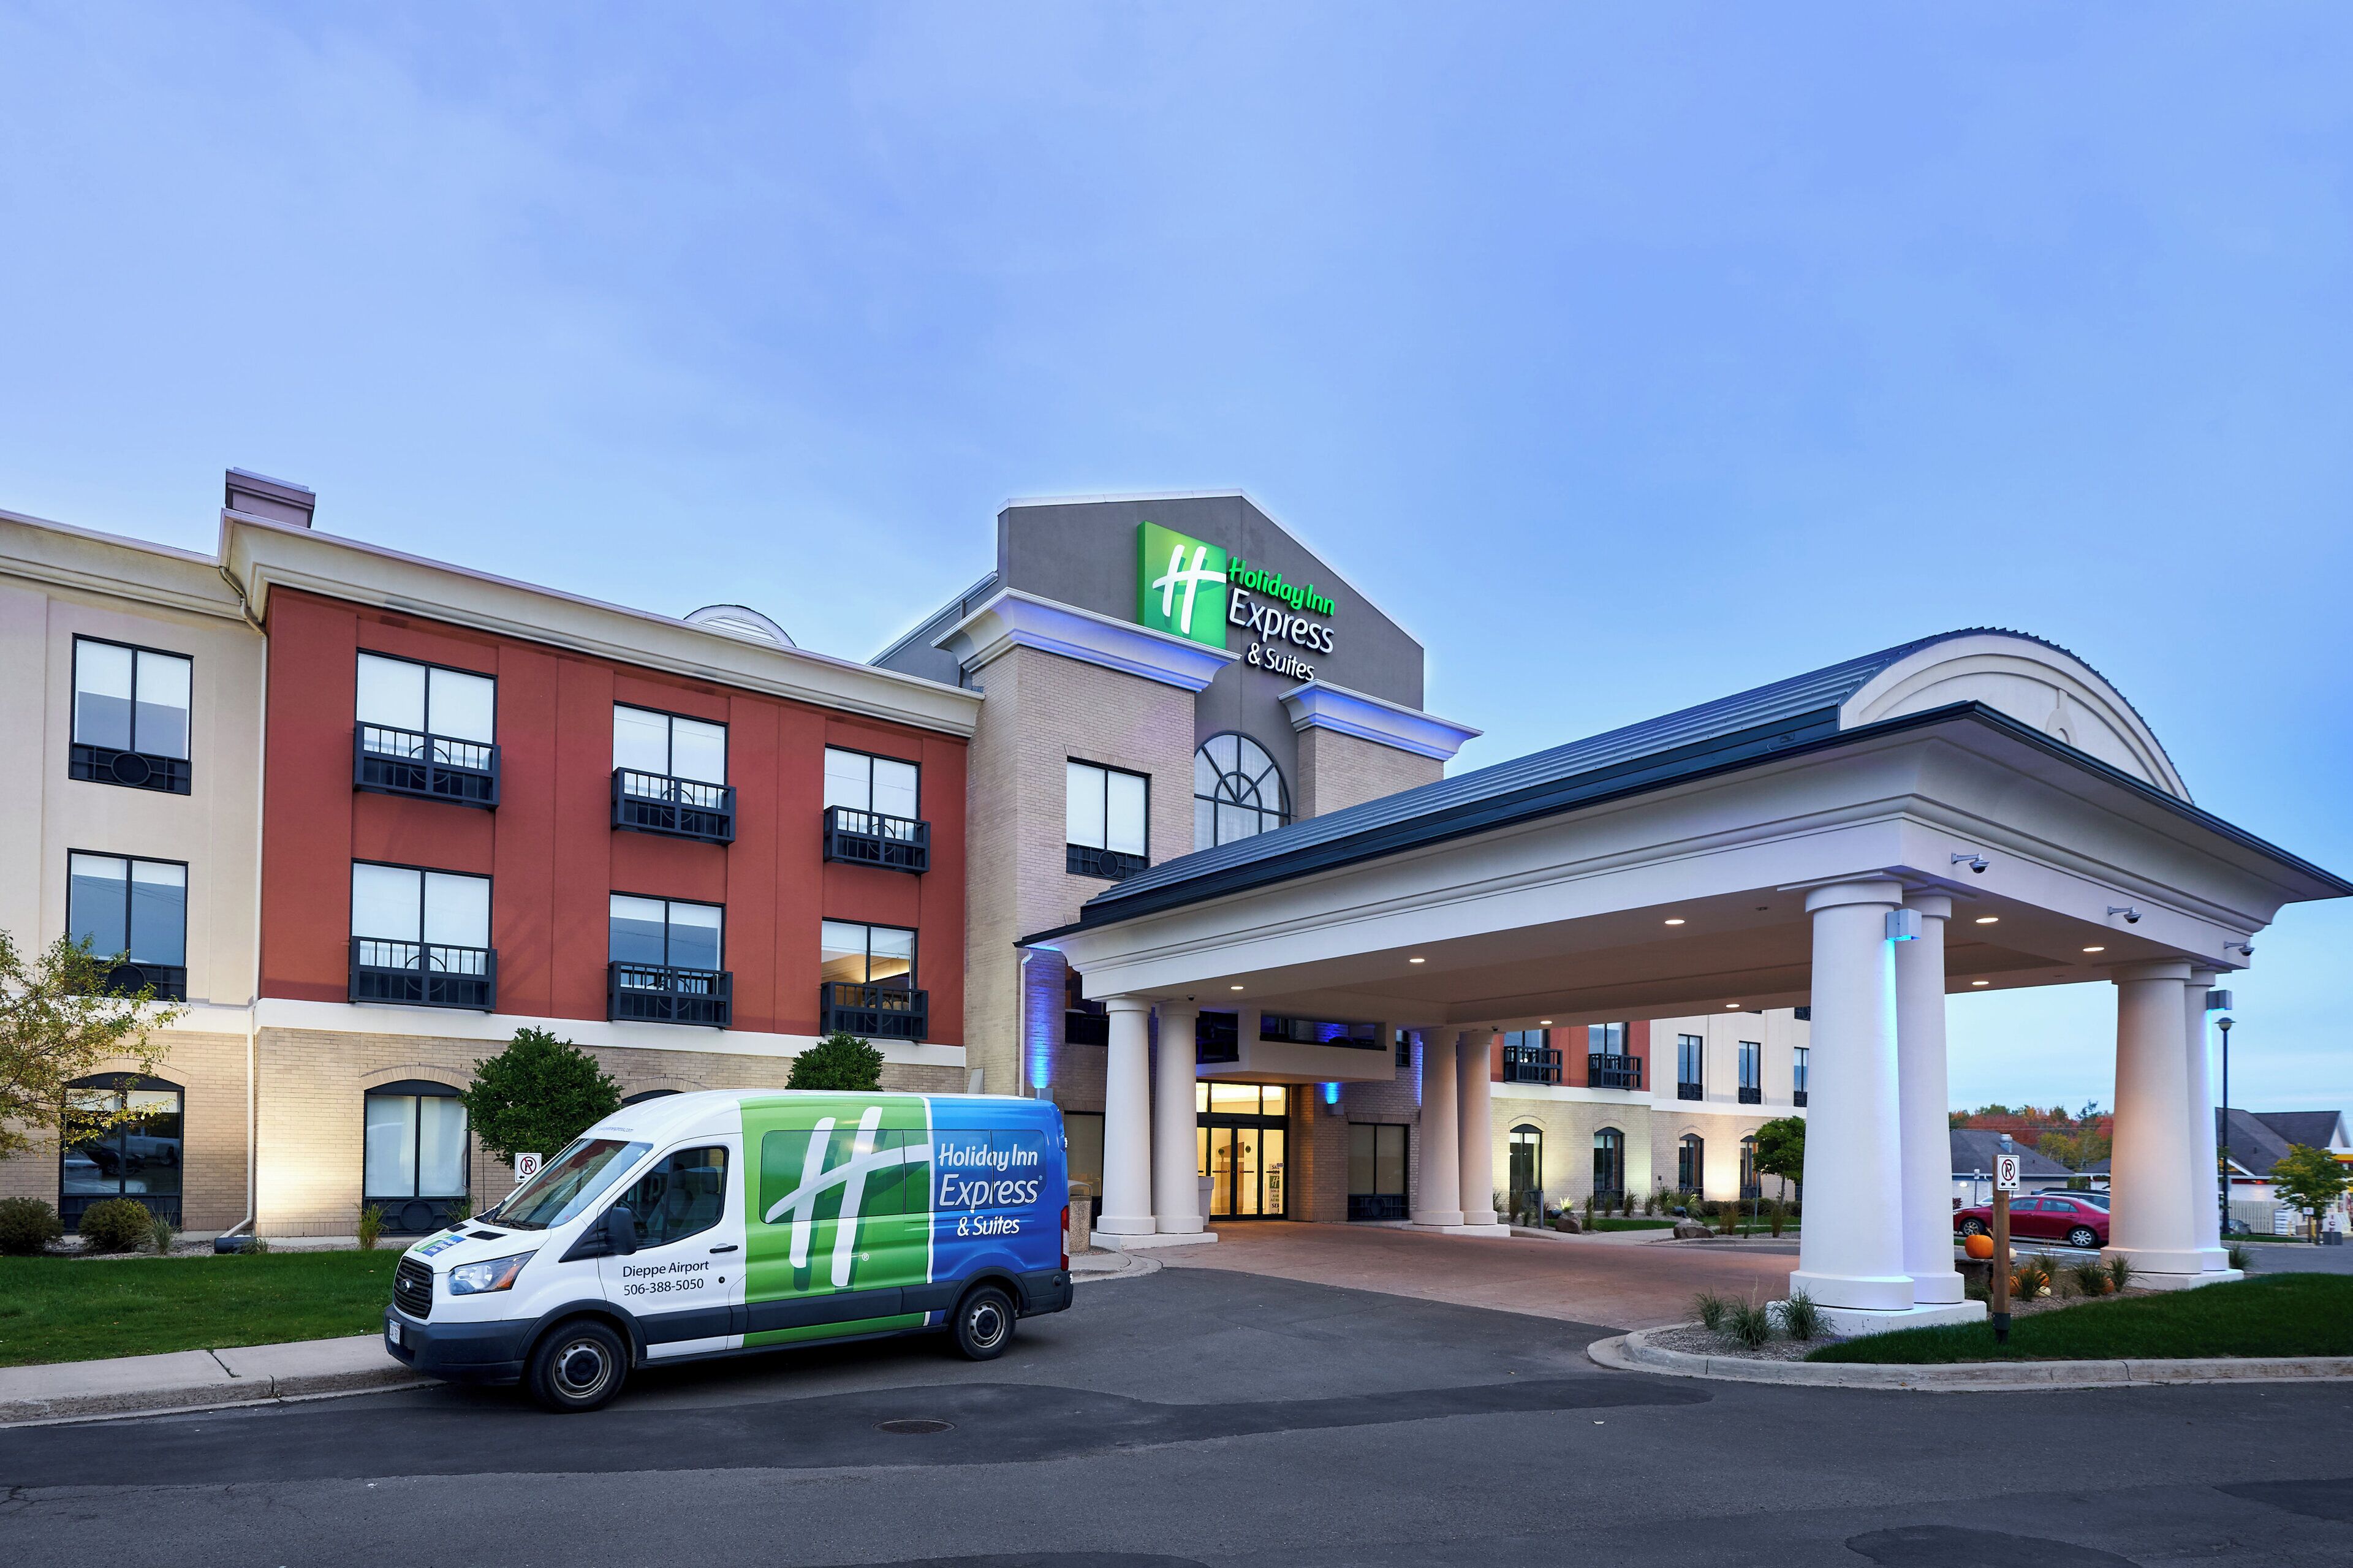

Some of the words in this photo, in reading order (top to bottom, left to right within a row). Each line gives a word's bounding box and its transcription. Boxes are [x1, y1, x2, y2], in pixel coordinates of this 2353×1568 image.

[1229, 556, 1305, 610] Holiday
[1306, 583, 1335, 616] Inn
[1228, 587, 1335, 654] Express
[1247, 642, 1261, 665] &
[1264, 647, 1315, 681] Suites
[938, 1143, 1010, 1172] Holiday
[1011, 1143, 1038, 1167] Inn
[939, 1173, 1040, 1214] Express
[957, 1216, 969, 1237] &
[972, 1216, 1020, 1236] Suites
[623, 1265, 666, 1278] Dieppe
[668, 1261, 710, 1275] Airport
[624, 1278, 704, 1296] 506-388-5050
